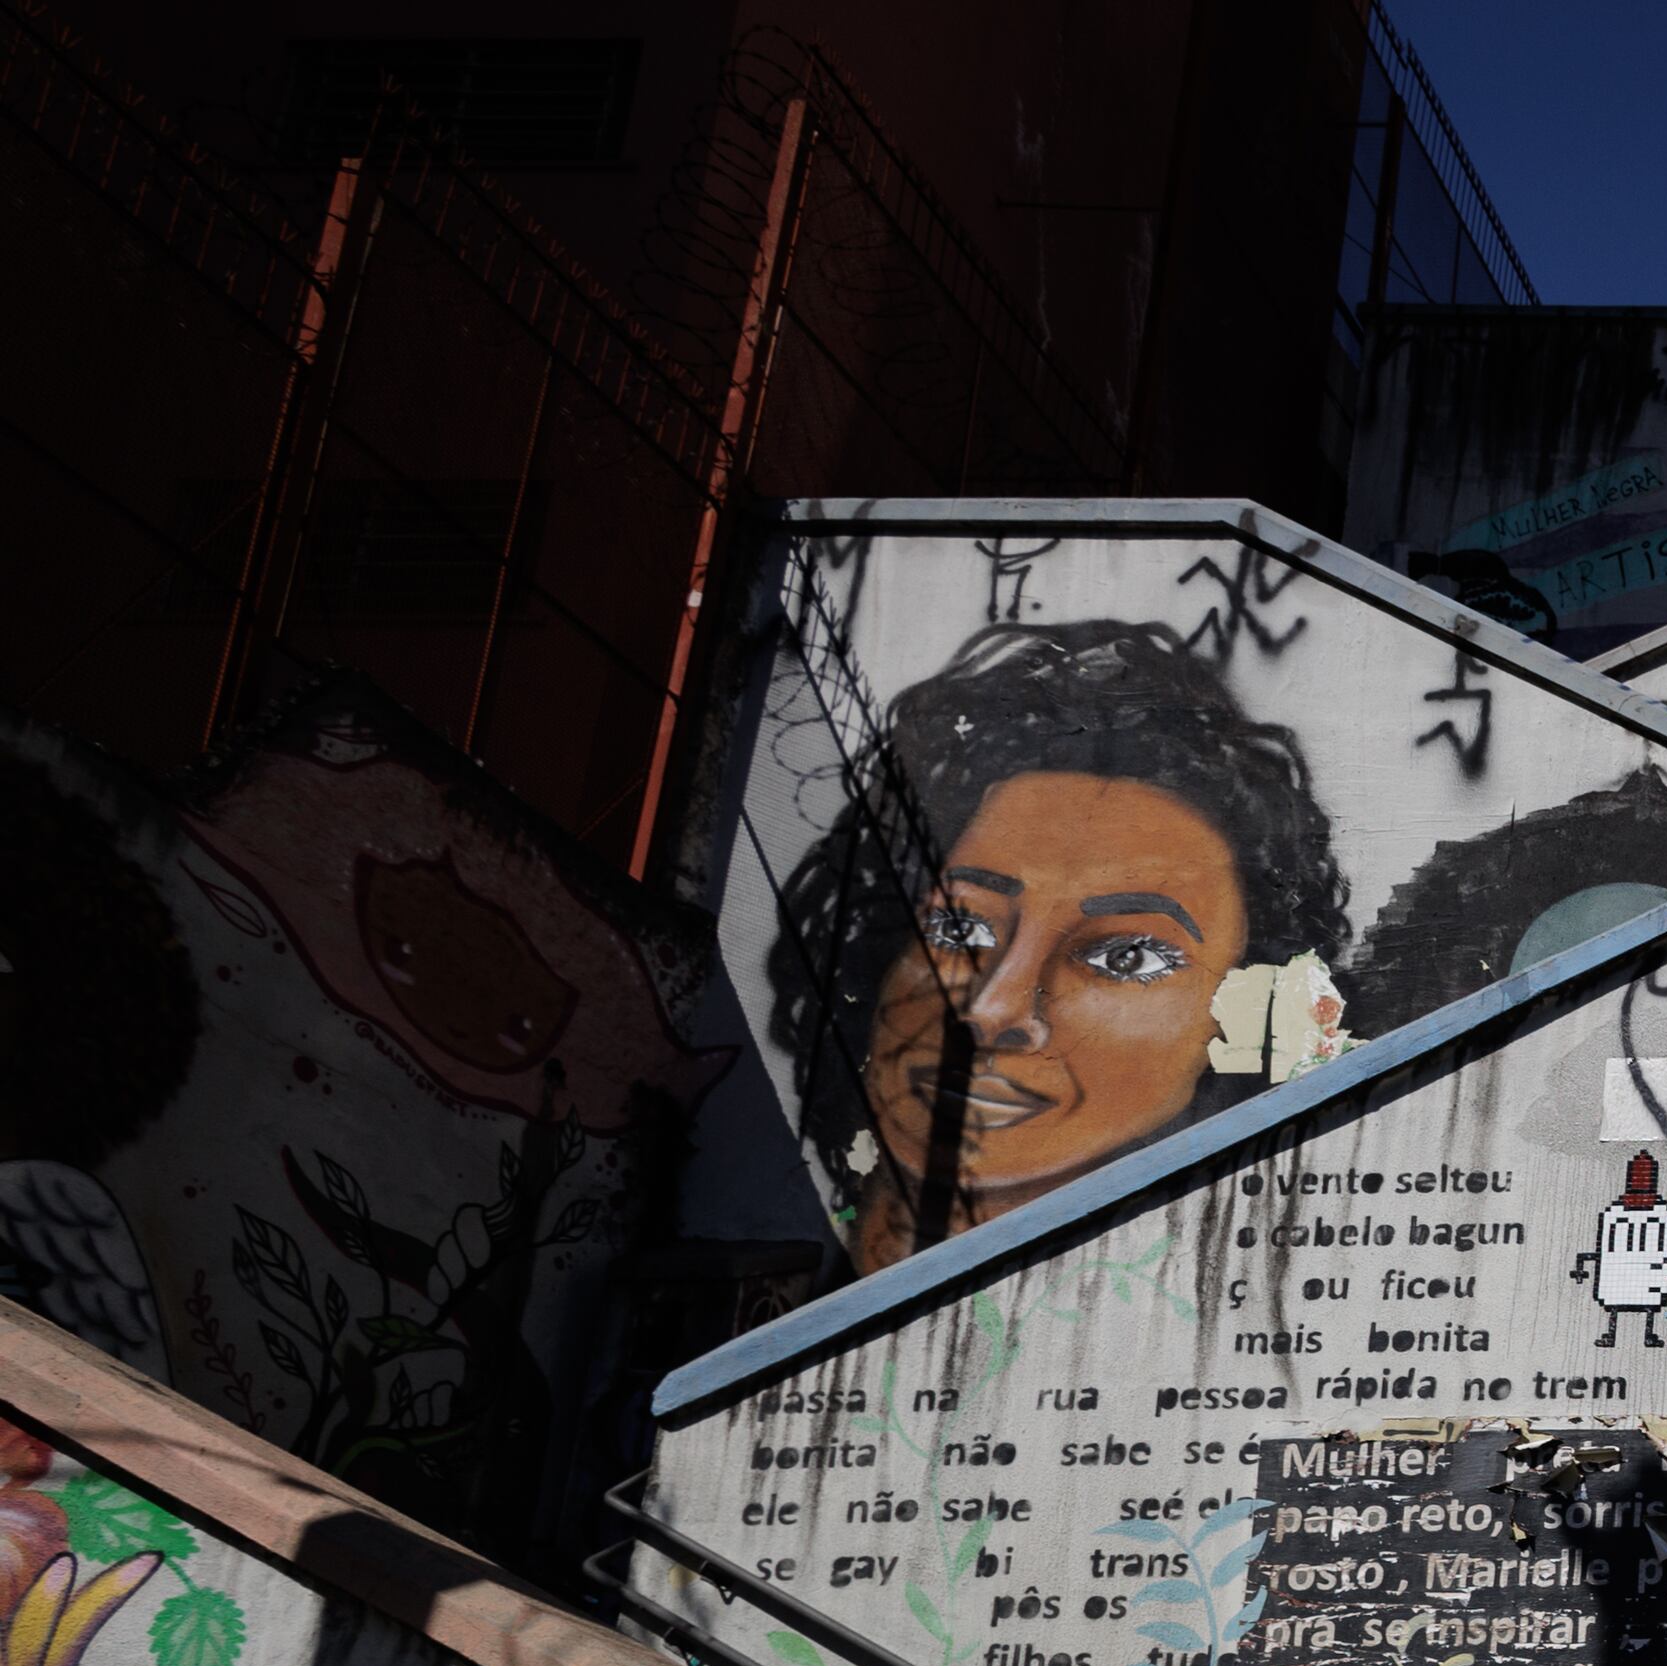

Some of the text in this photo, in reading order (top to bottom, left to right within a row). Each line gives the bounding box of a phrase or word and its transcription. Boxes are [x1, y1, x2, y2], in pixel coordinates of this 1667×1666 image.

[1277, 1165, 1384, 1196] vento
[1269, 1217, 1396, 1250] cabelo
[1408, 1215, 1526, 1253] bagun
[1302, 1275, 1350, 1301] ou
[1382, 1268, 1477, 1302] ficou
[1235, 1321, 1491, 1355] mais bonita
[755, 1367, 1629, 1422] passa na rua pessoa rápida no trem
[750, 1429, 1263, 1471] bonita não sabe se é
[1281, 1440, 1446, 1479] Mulher
[741, 1490, 799, 1526] ele
[845, 1491, 919, 1524] não
[941, 1489, 1032, 1523] sabe
[1273, 1502, 1388, 1543] papo
[756, 1546, 1188, 1588] se gay bi trans
[1424, 1547, 1610, 1590] Marielle
[991, 1588, 1128, 1626] pôs os
[1265, 1614, 1336, 1651] pra
[1425, 1610, 1597, 1653] inspirar
